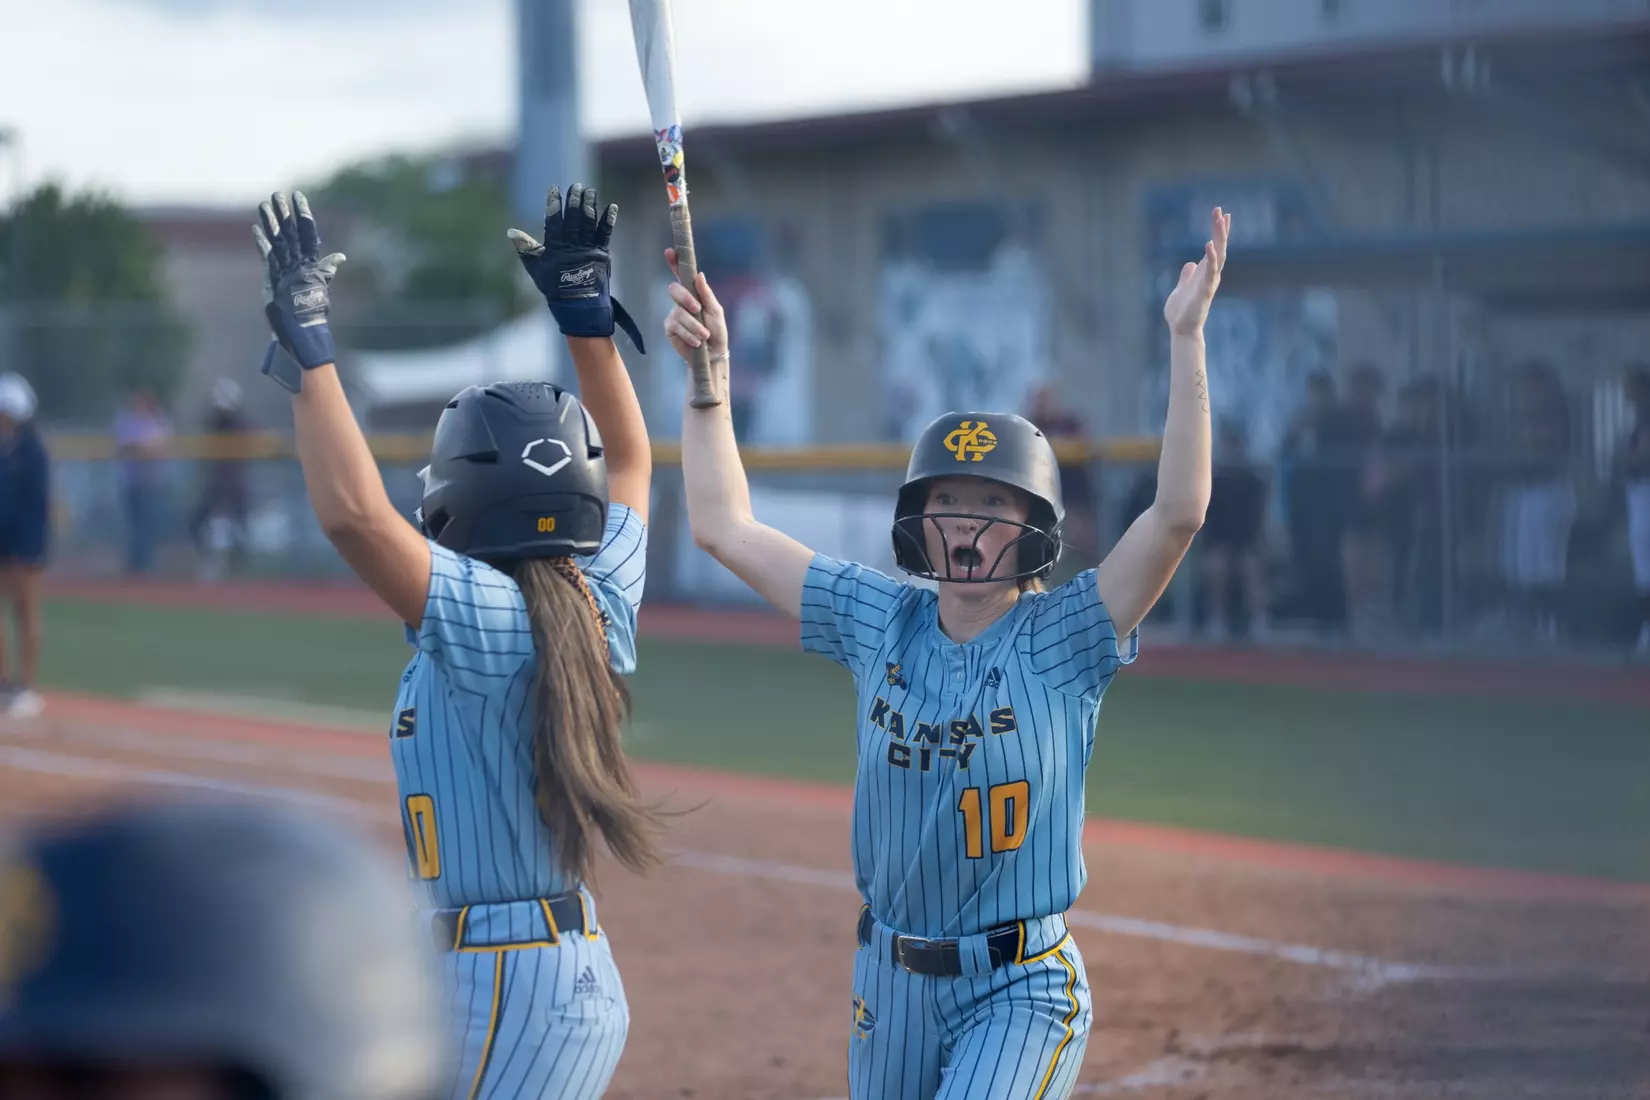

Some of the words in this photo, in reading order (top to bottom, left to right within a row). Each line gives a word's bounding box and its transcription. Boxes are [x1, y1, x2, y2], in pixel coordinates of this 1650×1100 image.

[537, 516, 555, 532] 00
[870, 696, 1016, 745] KANSAS
[957, 779, 1030, 860] 10
